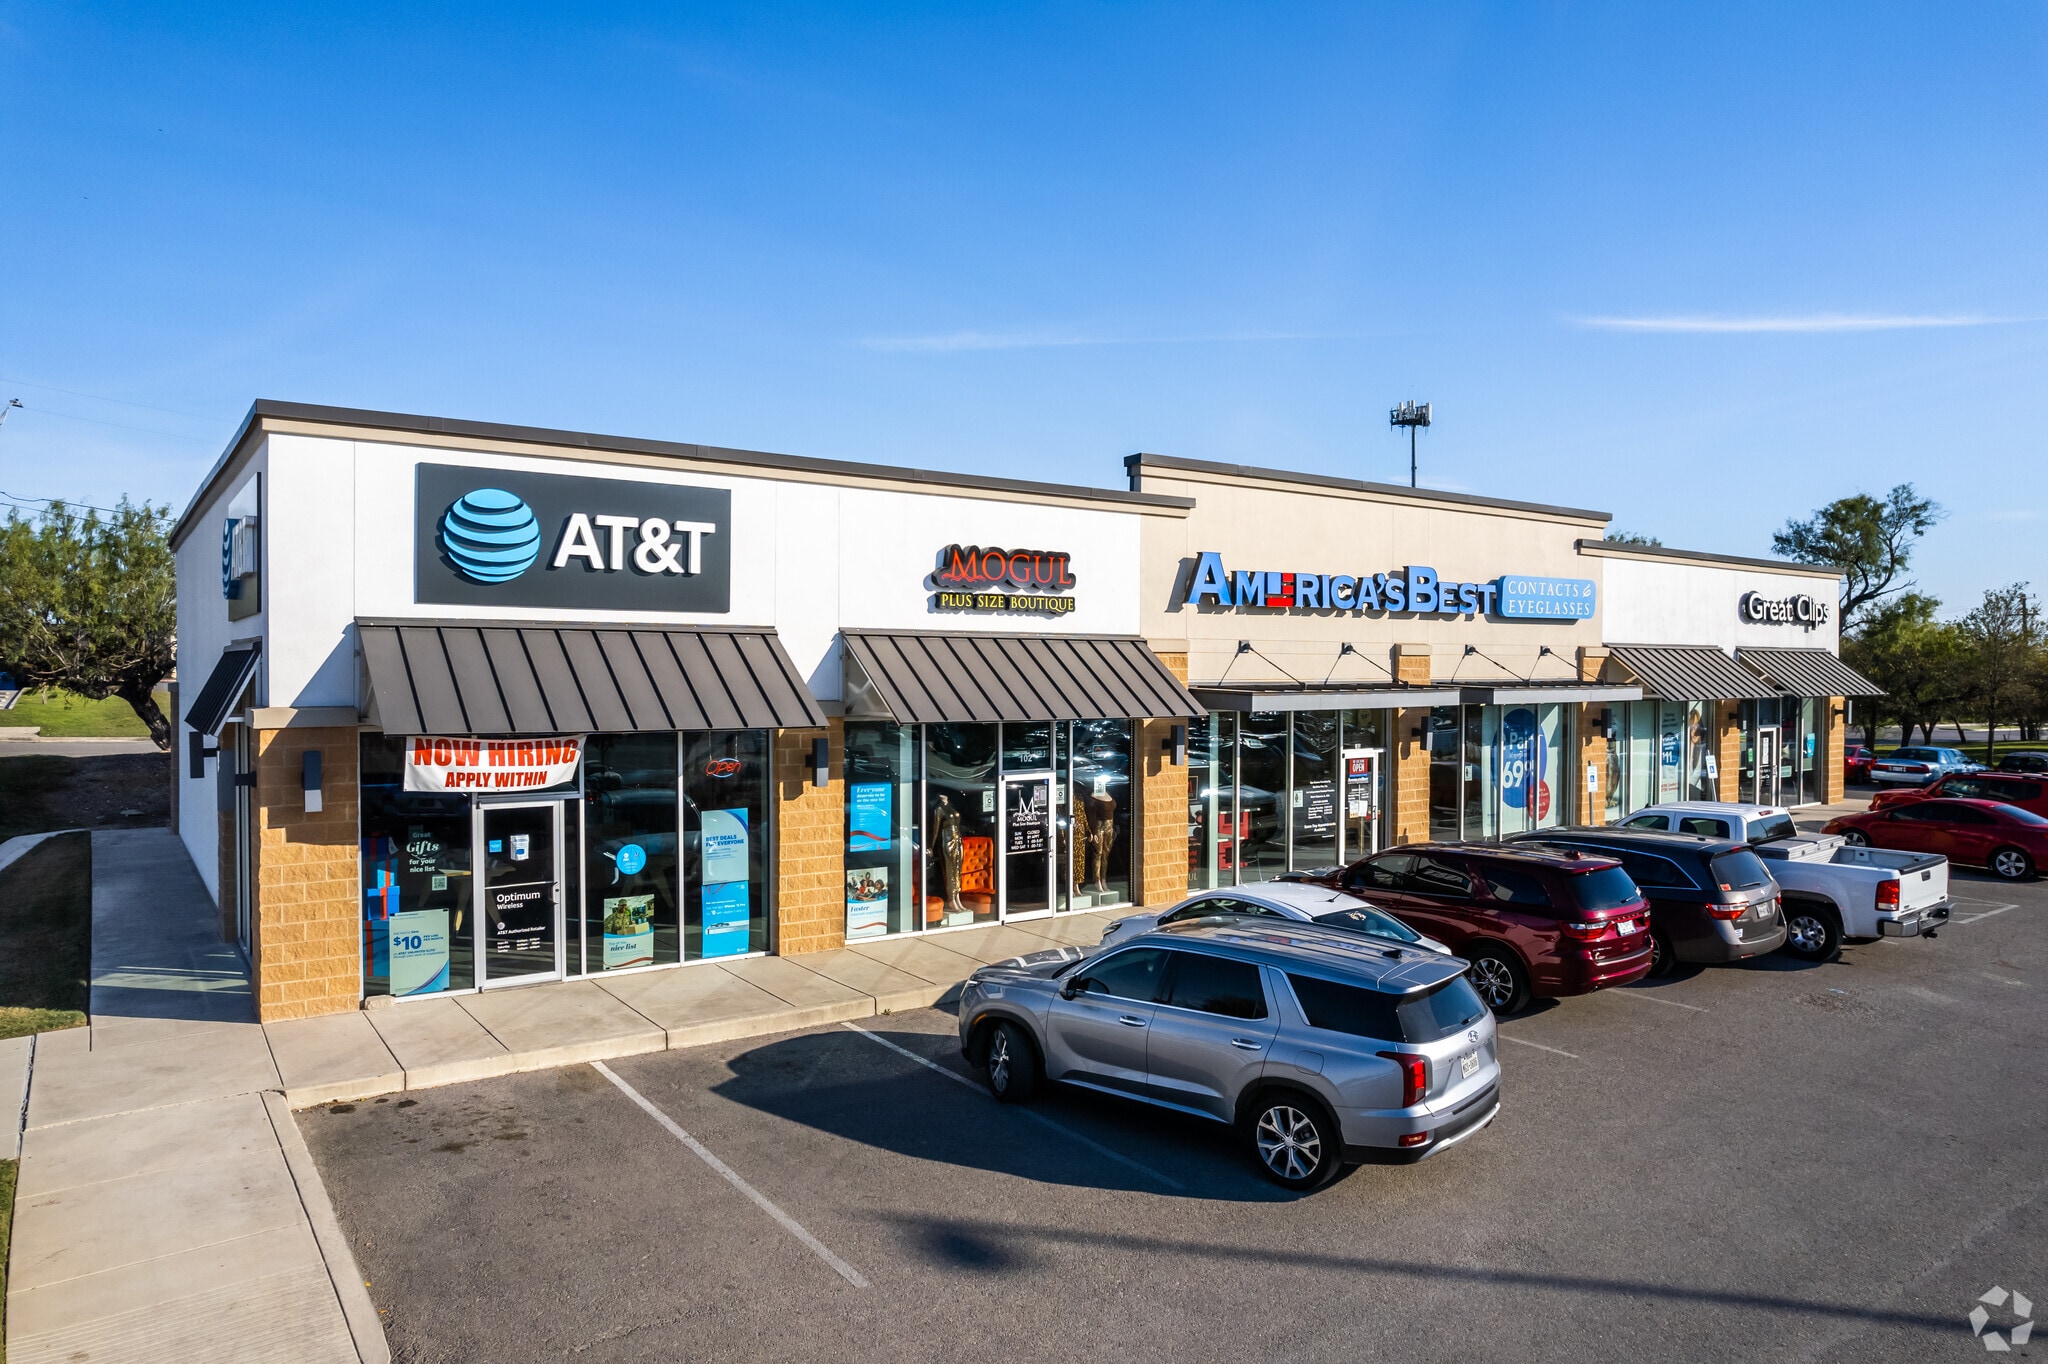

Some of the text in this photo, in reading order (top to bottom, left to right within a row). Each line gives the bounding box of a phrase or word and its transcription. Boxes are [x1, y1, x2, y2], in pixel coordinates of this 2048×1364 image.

[553, 512, 716, 574] AT&T
[941, 549, 1072, 585] MOGUL
[1186, 551, 1496, 615] AMERICA'S BEST
[1508, 581, 1592, 598] CONTACTS &
[941, 593, 1074, 612] PLUS SIZE BOUTIQUE
[1508, 599, 1590, 616] EYEGLASSES
[1750, 592, 1829, 628] Great Clips
[414, 738, 579, 766] NOW HIRING
[1020, 754, 1032, 762] 102
[706, 760, 742, 774] Open
[1353, 764, 1364, 772] OPEN
[444, 771, 547, 788] APPLY WITHIN
[406, 840, 440, 855] Gifts
[496, 892, 540, 903] Optimum
[393, 935, 422, 950] $10
